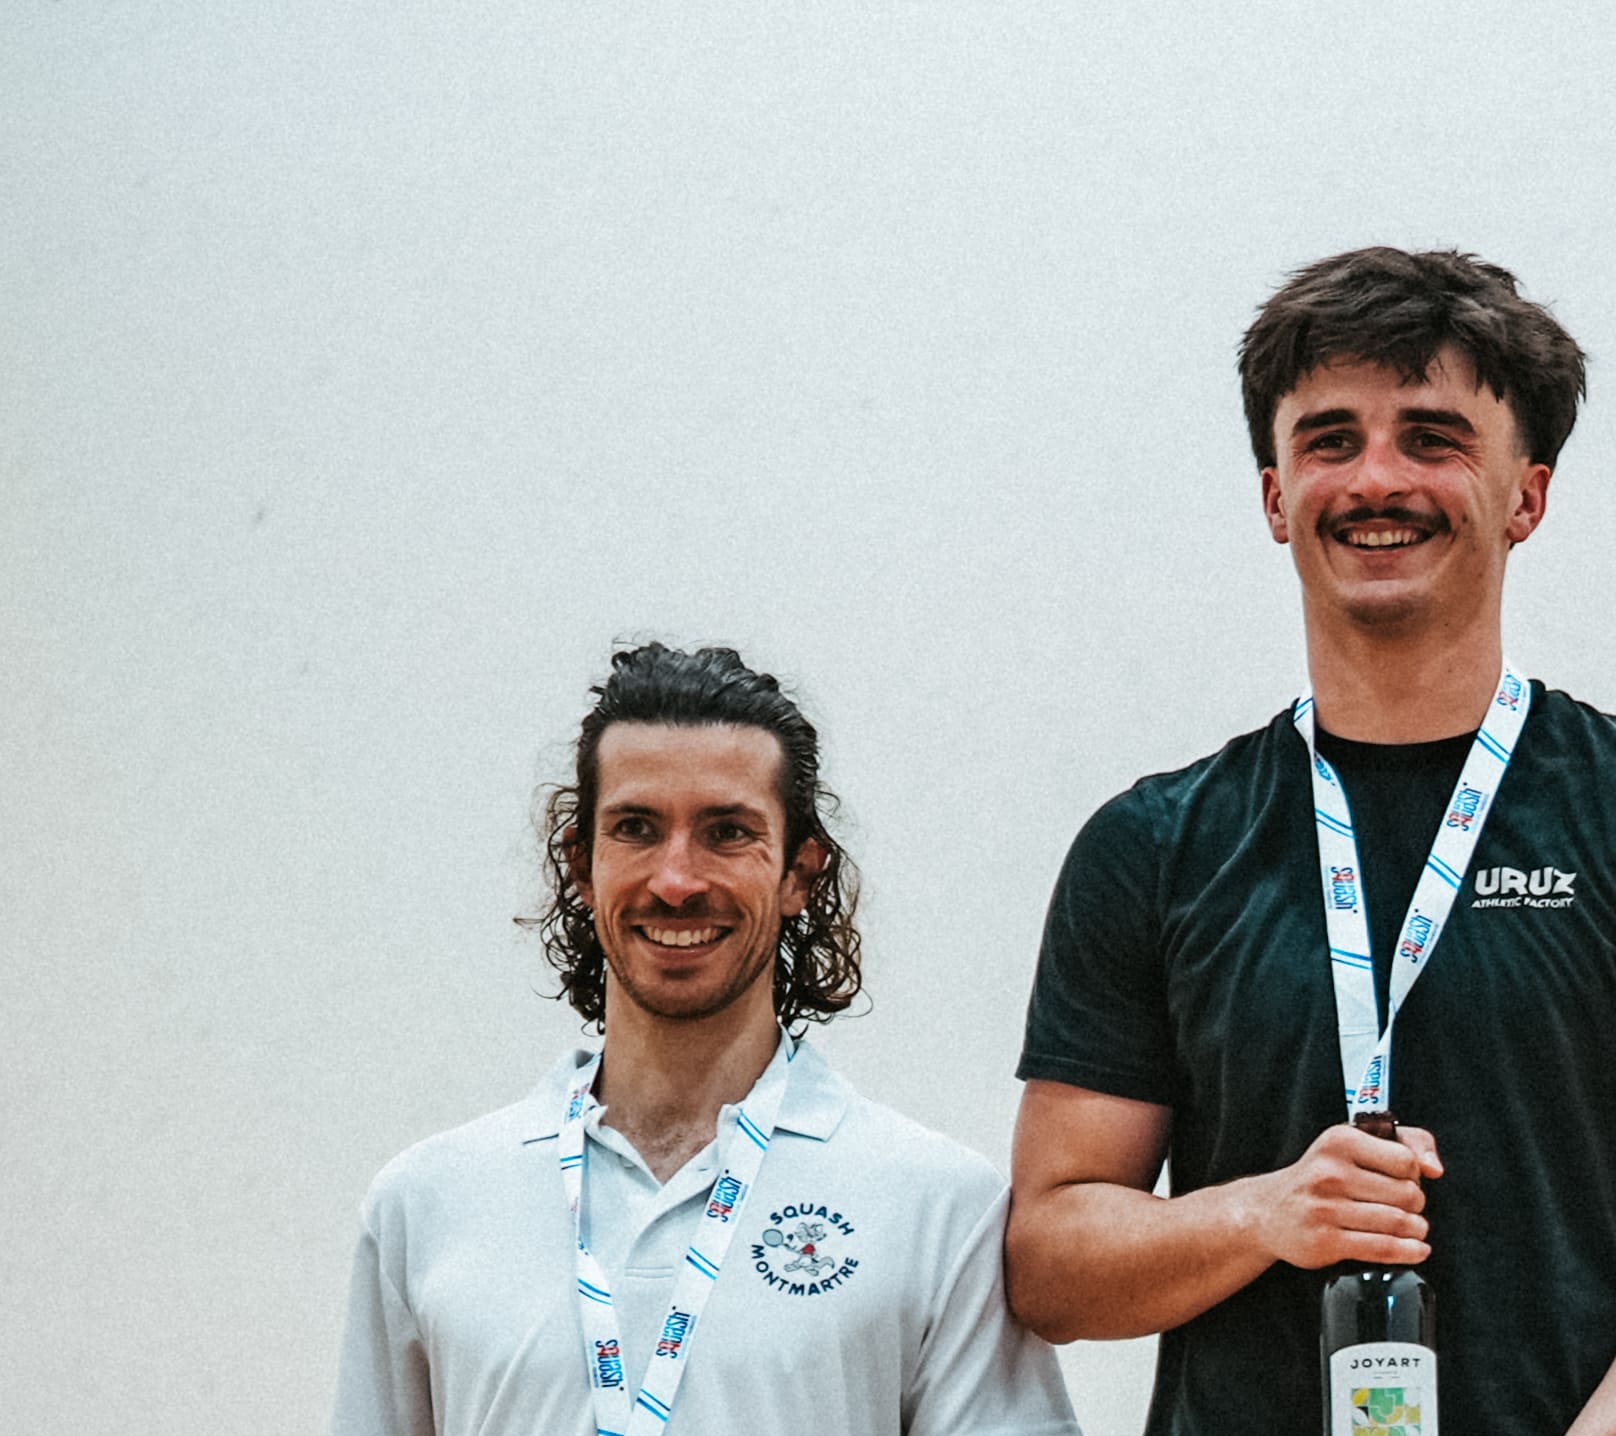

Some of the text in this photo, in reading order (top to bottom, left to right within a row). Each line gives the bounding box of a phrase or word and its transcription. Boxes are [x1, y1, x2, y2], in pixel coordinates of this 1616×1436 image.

[1474, 866, 1577, 896] URUZ
[770, 1203, 855, 1236] SQUASH
[751, 1244, 859, 1296] MONTMARTRE
[1350, 1357, 1421, 1370] JOYART
